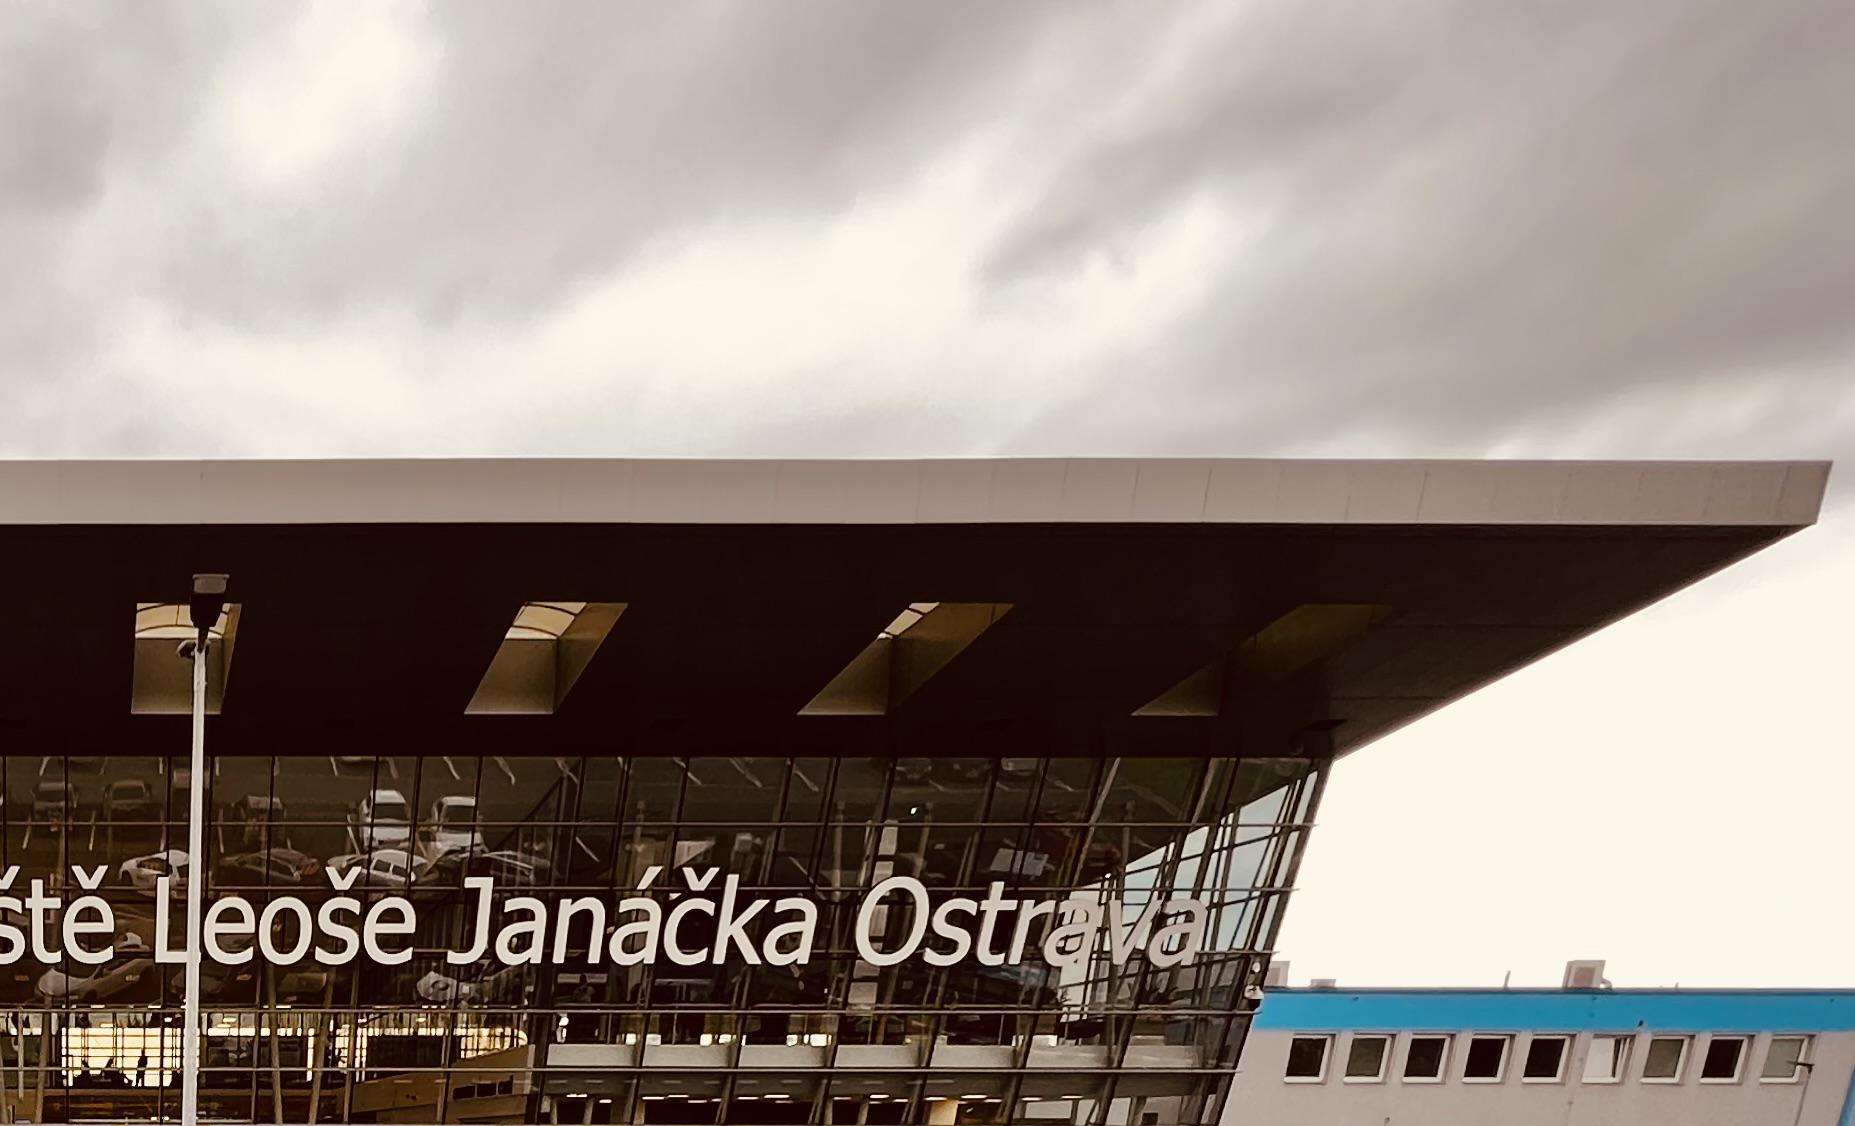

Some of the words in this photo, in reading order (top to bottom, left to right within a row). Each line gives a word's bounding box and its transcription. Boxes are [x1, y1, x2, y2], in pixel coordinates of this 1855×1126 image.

[155, 865, 417, 966] Leoše
[446, 867, 813, 967] Janáčka
[855, 876, 1208, 967] Ostrava
